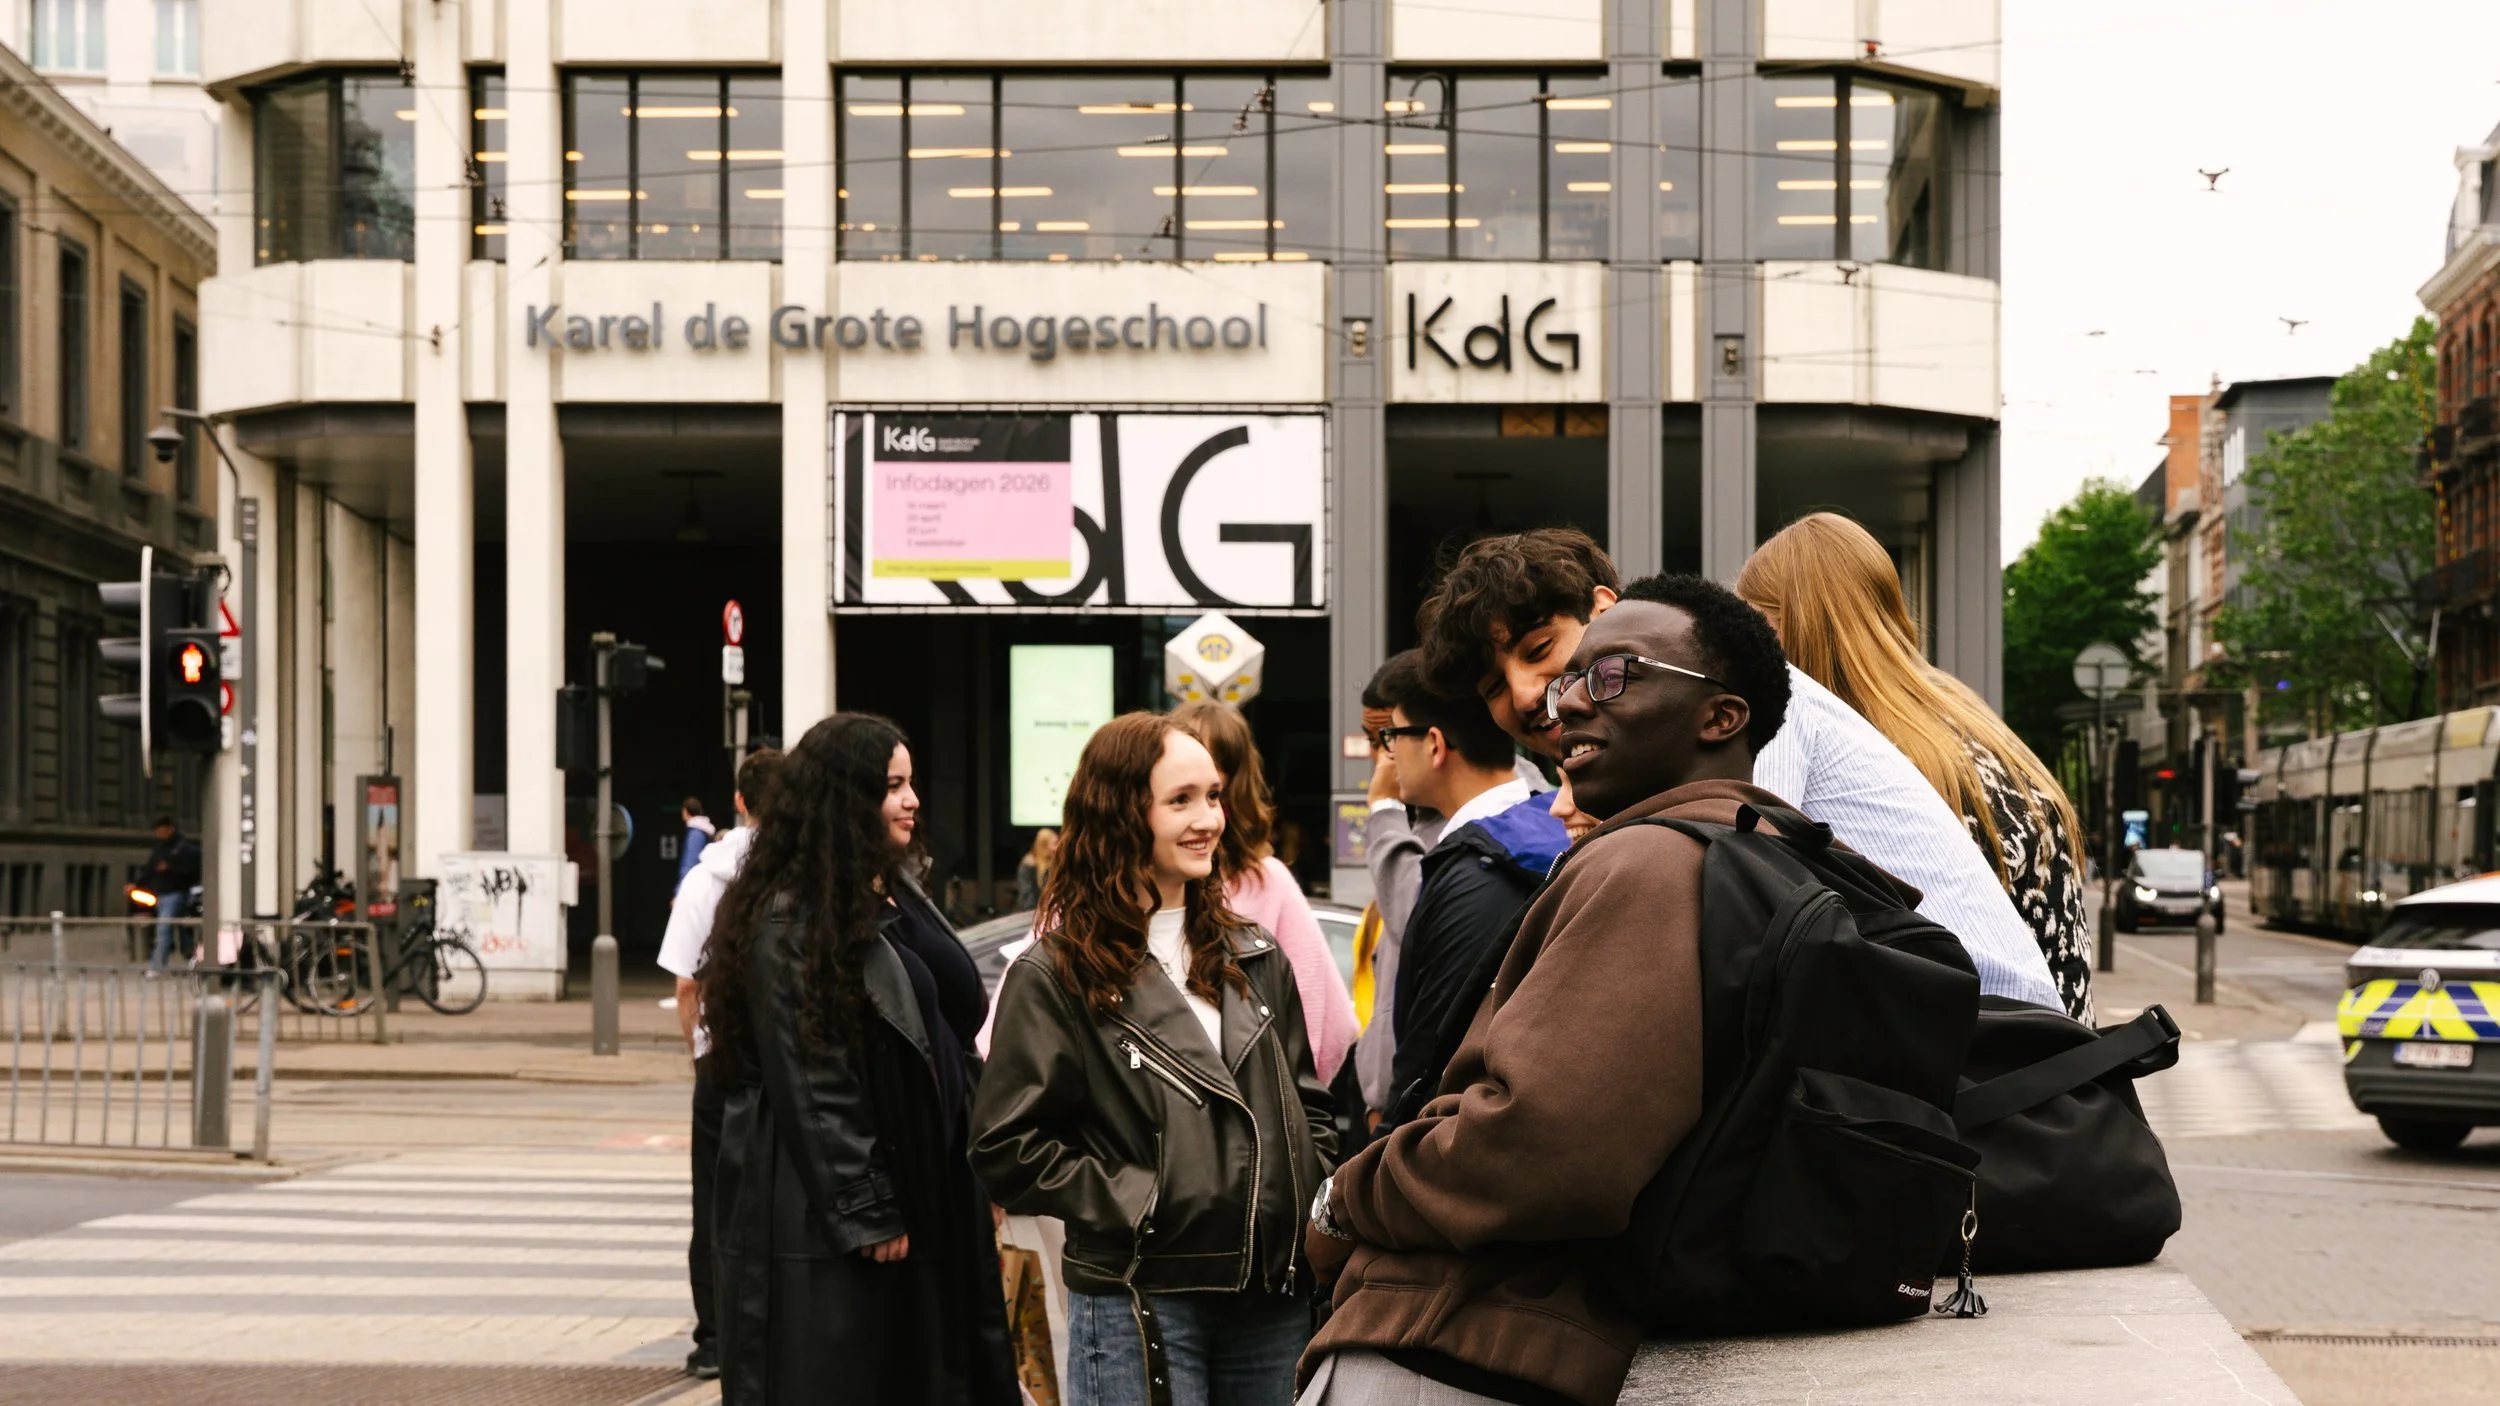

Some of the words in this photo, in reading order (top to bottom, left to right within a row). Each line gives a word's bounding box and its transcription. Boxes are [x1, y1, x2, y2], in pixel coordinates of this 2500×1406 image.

[526, 303, 663, 350] Karel
[684, 303, 751, 349] de
[771, 304, 923, 351] Grote
[949, 303, 1268, 360] Hogeschool
[1408, 292, 1579, 373] KdG
[884, 425, 937, 452] KdG
[886, 473, 995, 496] Infodagen
[1000, 473, 1051, 493] 2026
